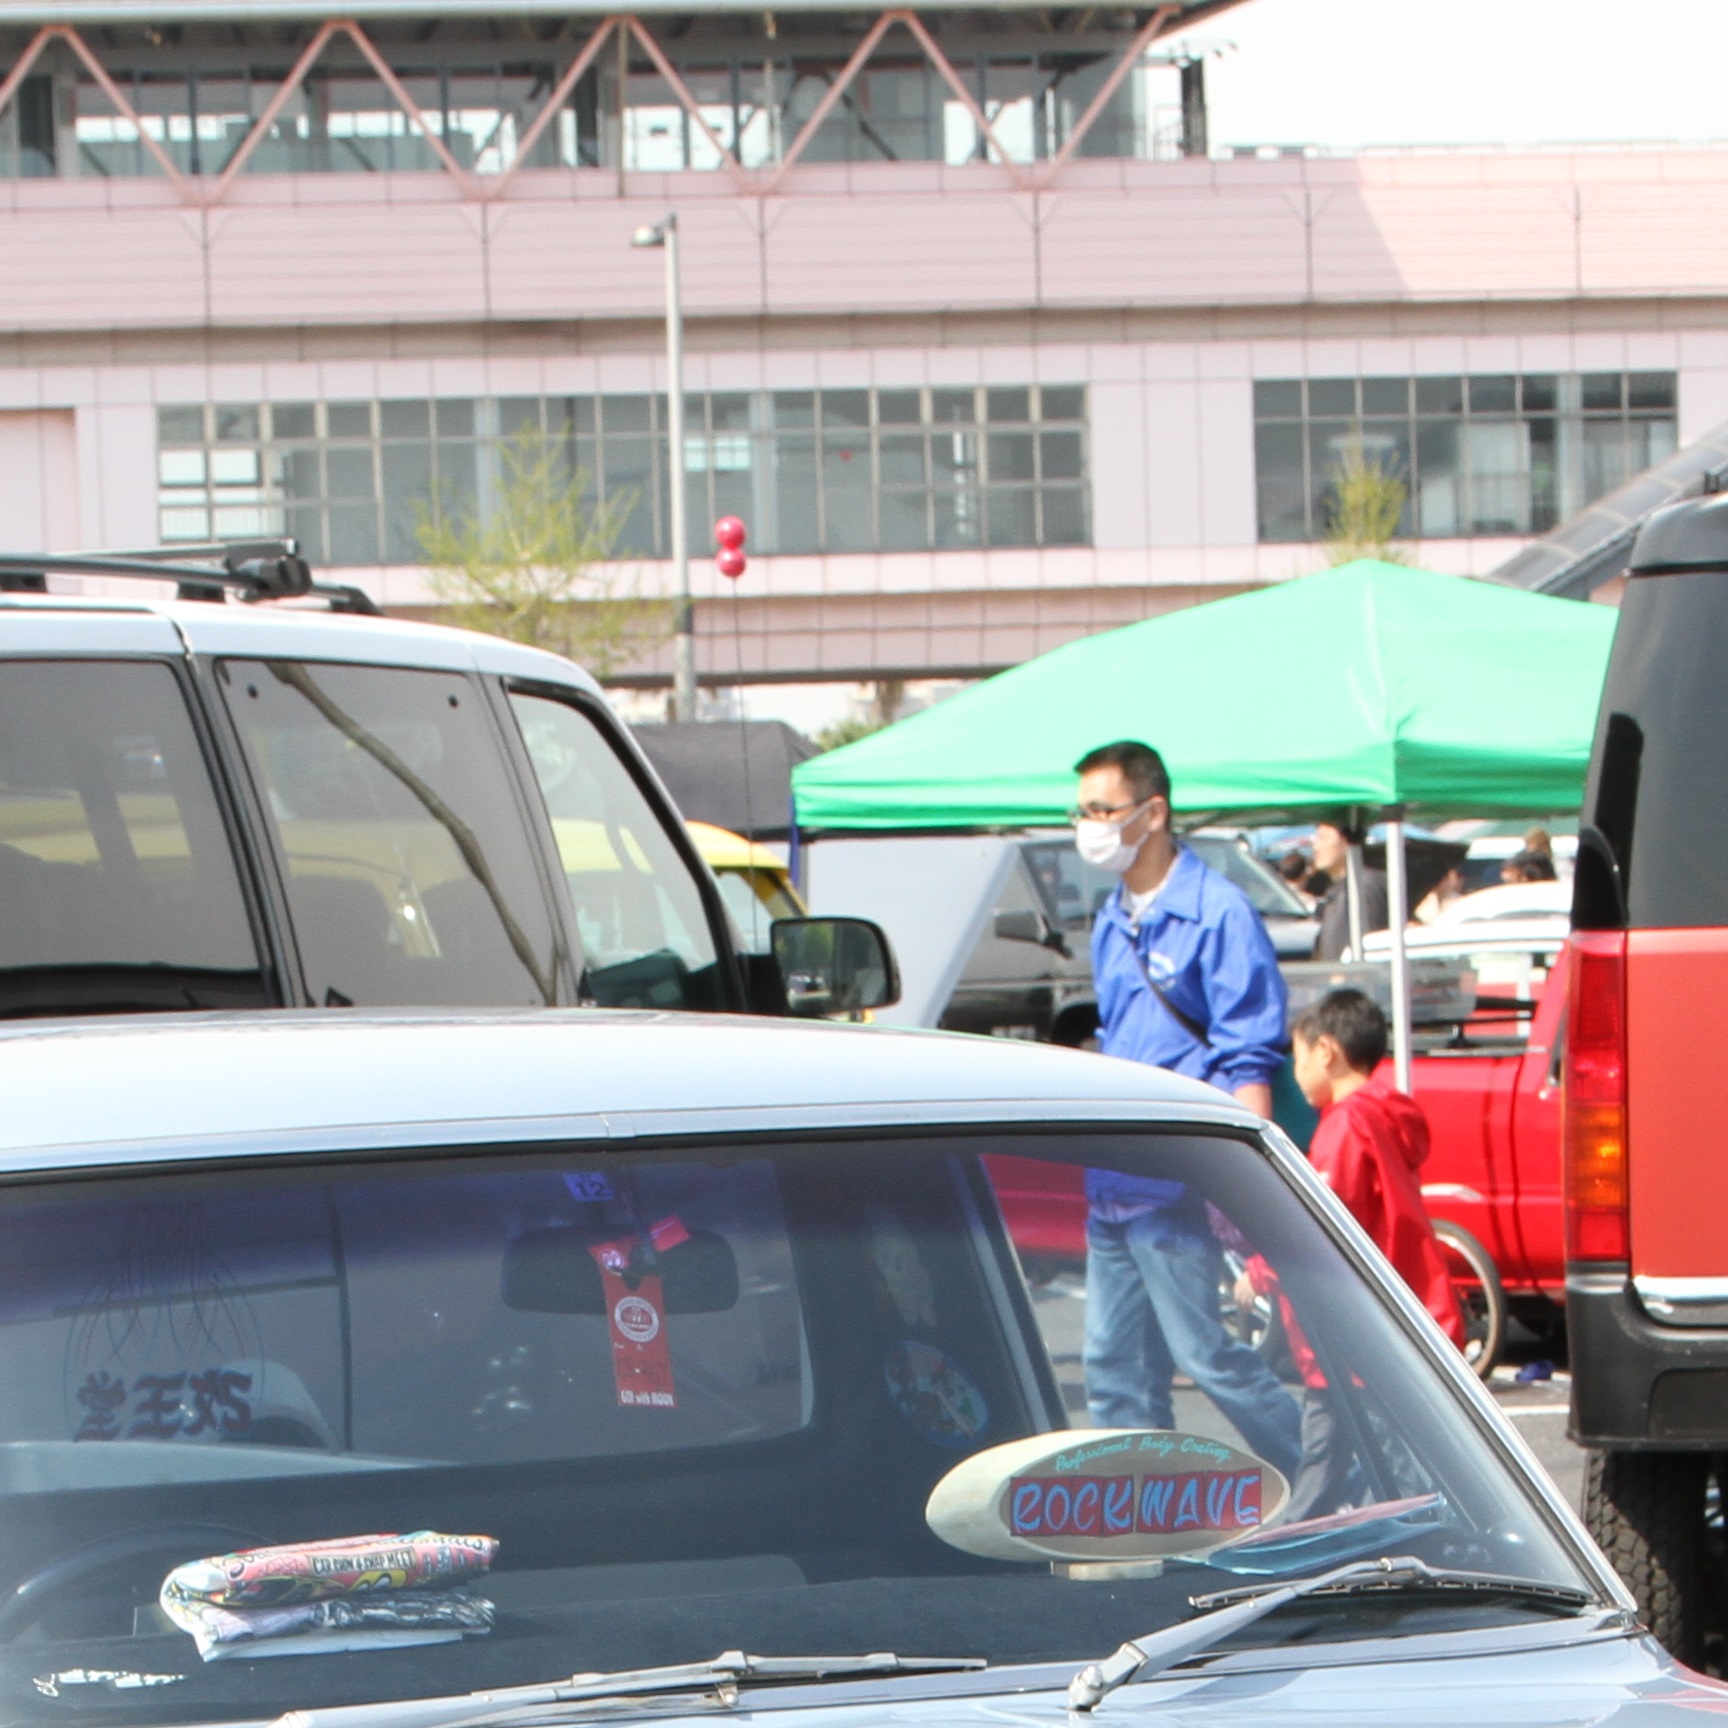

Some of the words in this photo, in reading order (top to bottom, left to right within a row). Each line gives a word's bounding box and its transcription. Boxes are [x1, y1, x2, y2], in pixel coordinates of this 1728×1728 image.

[1056, 1437, 1132, 1470] Professional
[1139, 1435, 1175, 1457] Body
[1180, 1437, 1232, 1463] Coating
[1012, 1480, 1132, 1532] ROCK
[1140, 1475, 1260, 1527] WAVE
[387, 1549, 414, 1568] MEET
